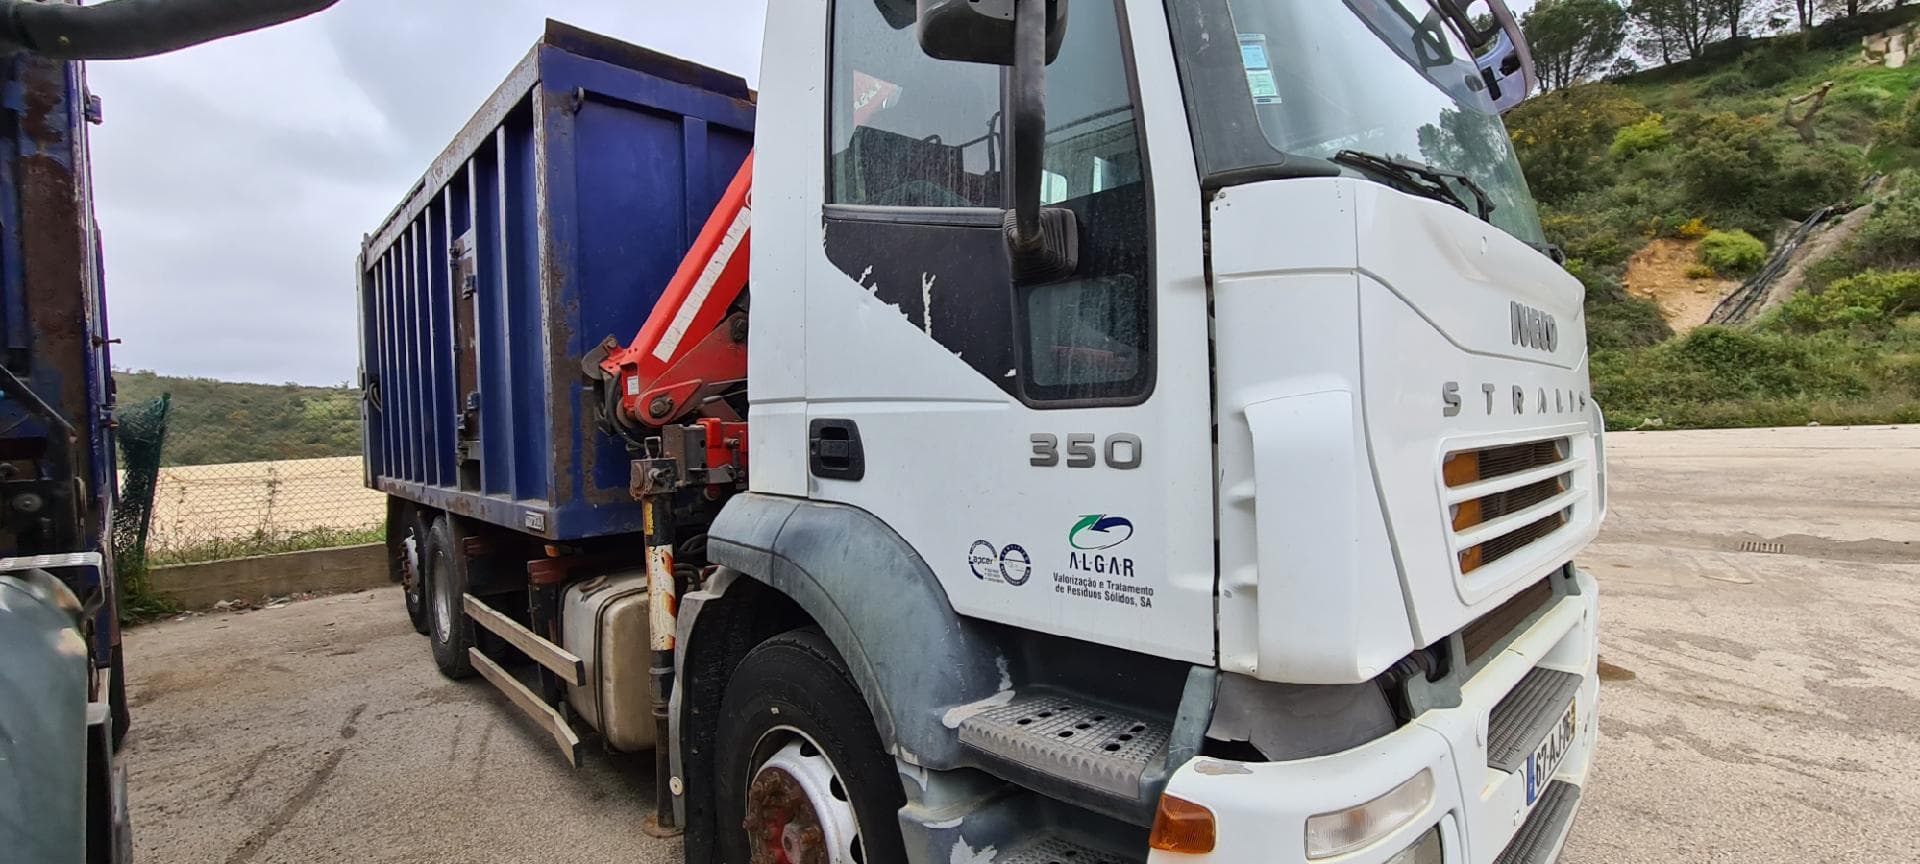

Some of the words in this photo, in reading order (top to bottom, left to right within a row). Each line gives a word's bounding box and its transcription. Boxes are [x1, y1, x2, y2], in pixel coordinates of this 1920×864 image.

[1442, 381, 1586, 418] STRALIS
[1030, 432, 1143, 470] 350
[1055, 584, 1065, 594] de
[1140, 596, 1152, 608] SA
[1099, 580, 1105, 589] e
[1106, 580, 1154, 597] Tratamento
